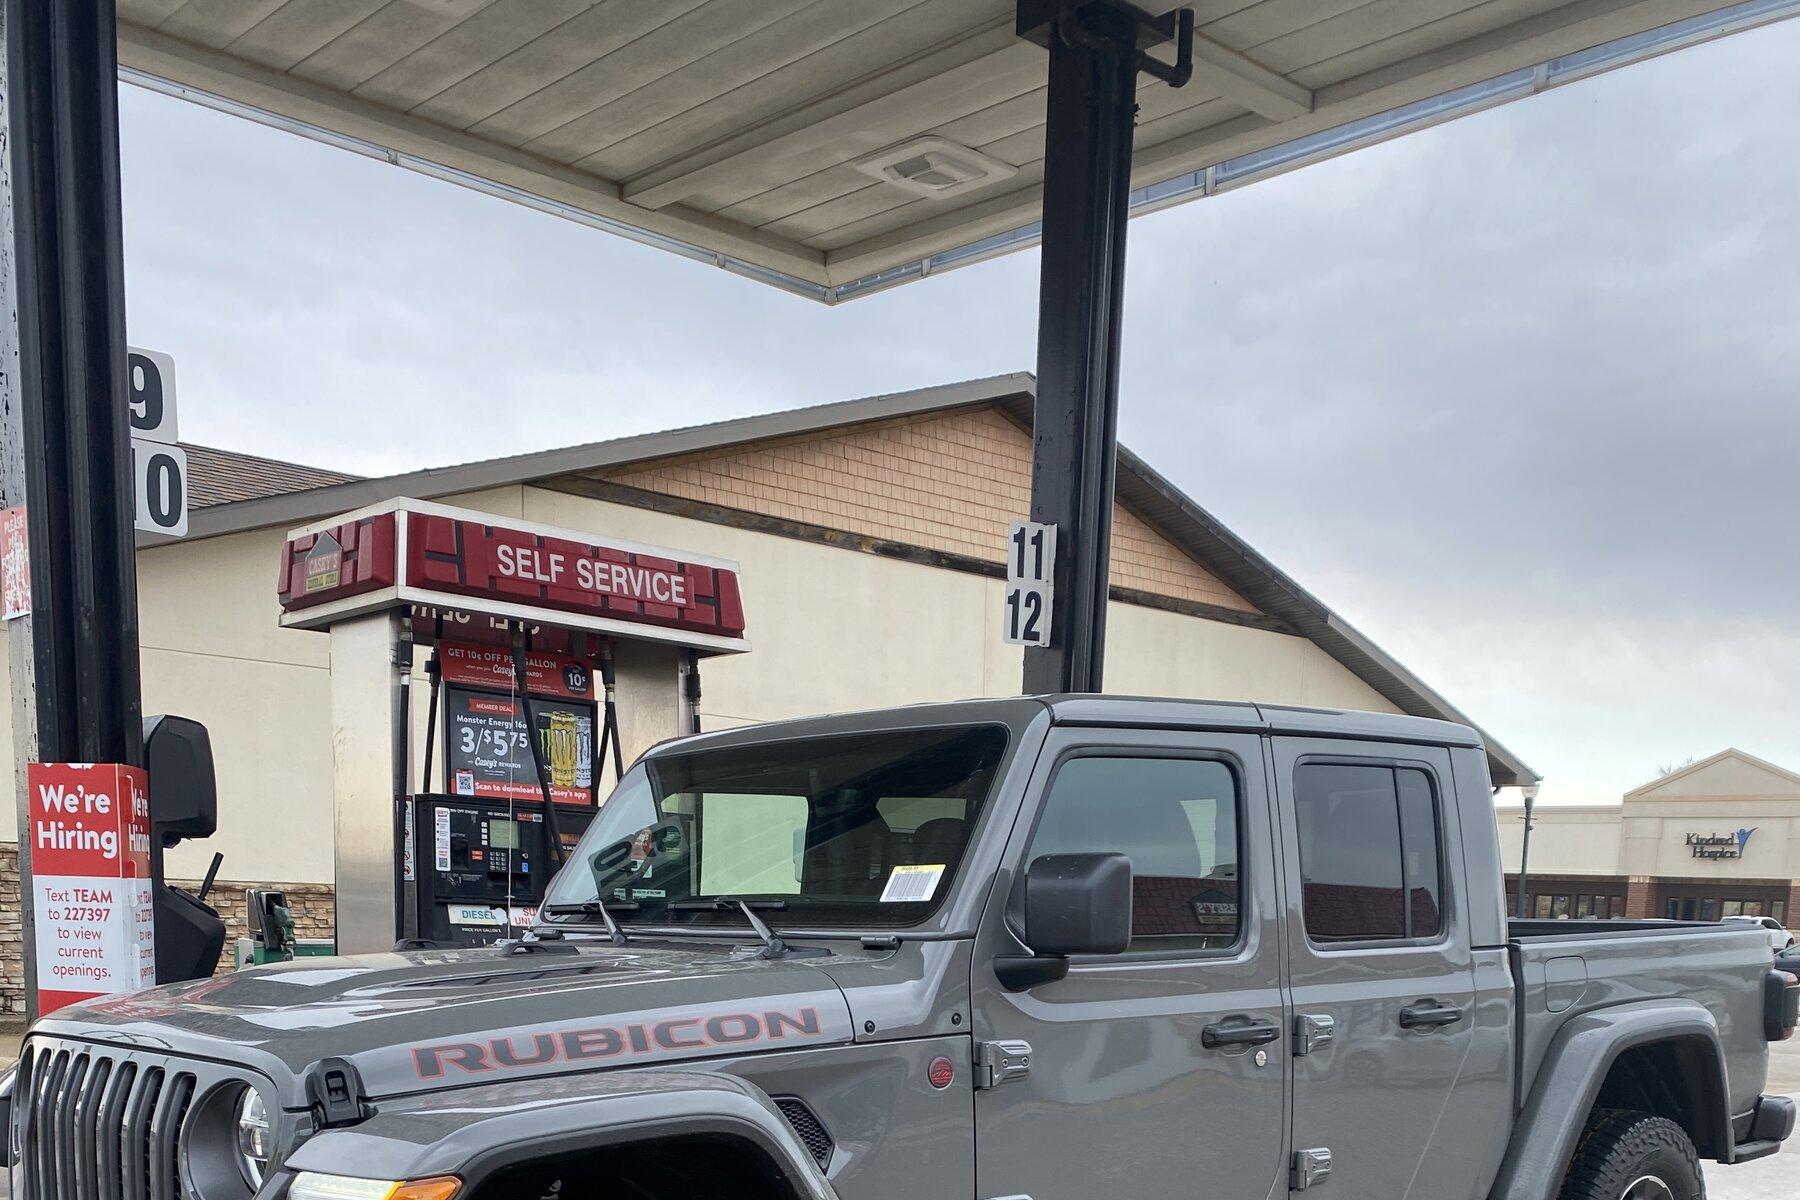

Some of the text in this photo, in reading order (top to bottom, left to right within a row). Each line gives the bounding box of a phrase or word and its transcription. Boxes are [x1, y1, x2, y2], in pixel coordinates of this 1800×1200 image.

[128, 353, 163, 431] 9
[1013, 526, 1043, 580] 11
[497, 544, 687, 604] SELF SERVICE
[1007, 588, 1042, 641] 12
[448, 648, 465, 658] GET
[484, 652, 502, 662] OFF
[476, 703, 513, 713] MEMBER DEAL
[456, 714, 528, 730] Monster Energy 16o
[474, 756, 521, 769] Casey's REWARDS
[38, 784, 111, 814] We're
[474, 781, 587, 800] Scan to download th Casey's app
[37, 820, 118, 859] Hiring
[1685, 831, 1736, 846] Kindred
[1691, 845, 1738, 861] Hospice
[45, 887, 113, 904] Text TEAM
[48, 907, 110, 922] to 227397
[57, 926, 102, 940] to view
[57, 946, 104, 959] current
[52, 963, 111, 981] openings.
[410, 1007, 822, 1080] RUBICON
